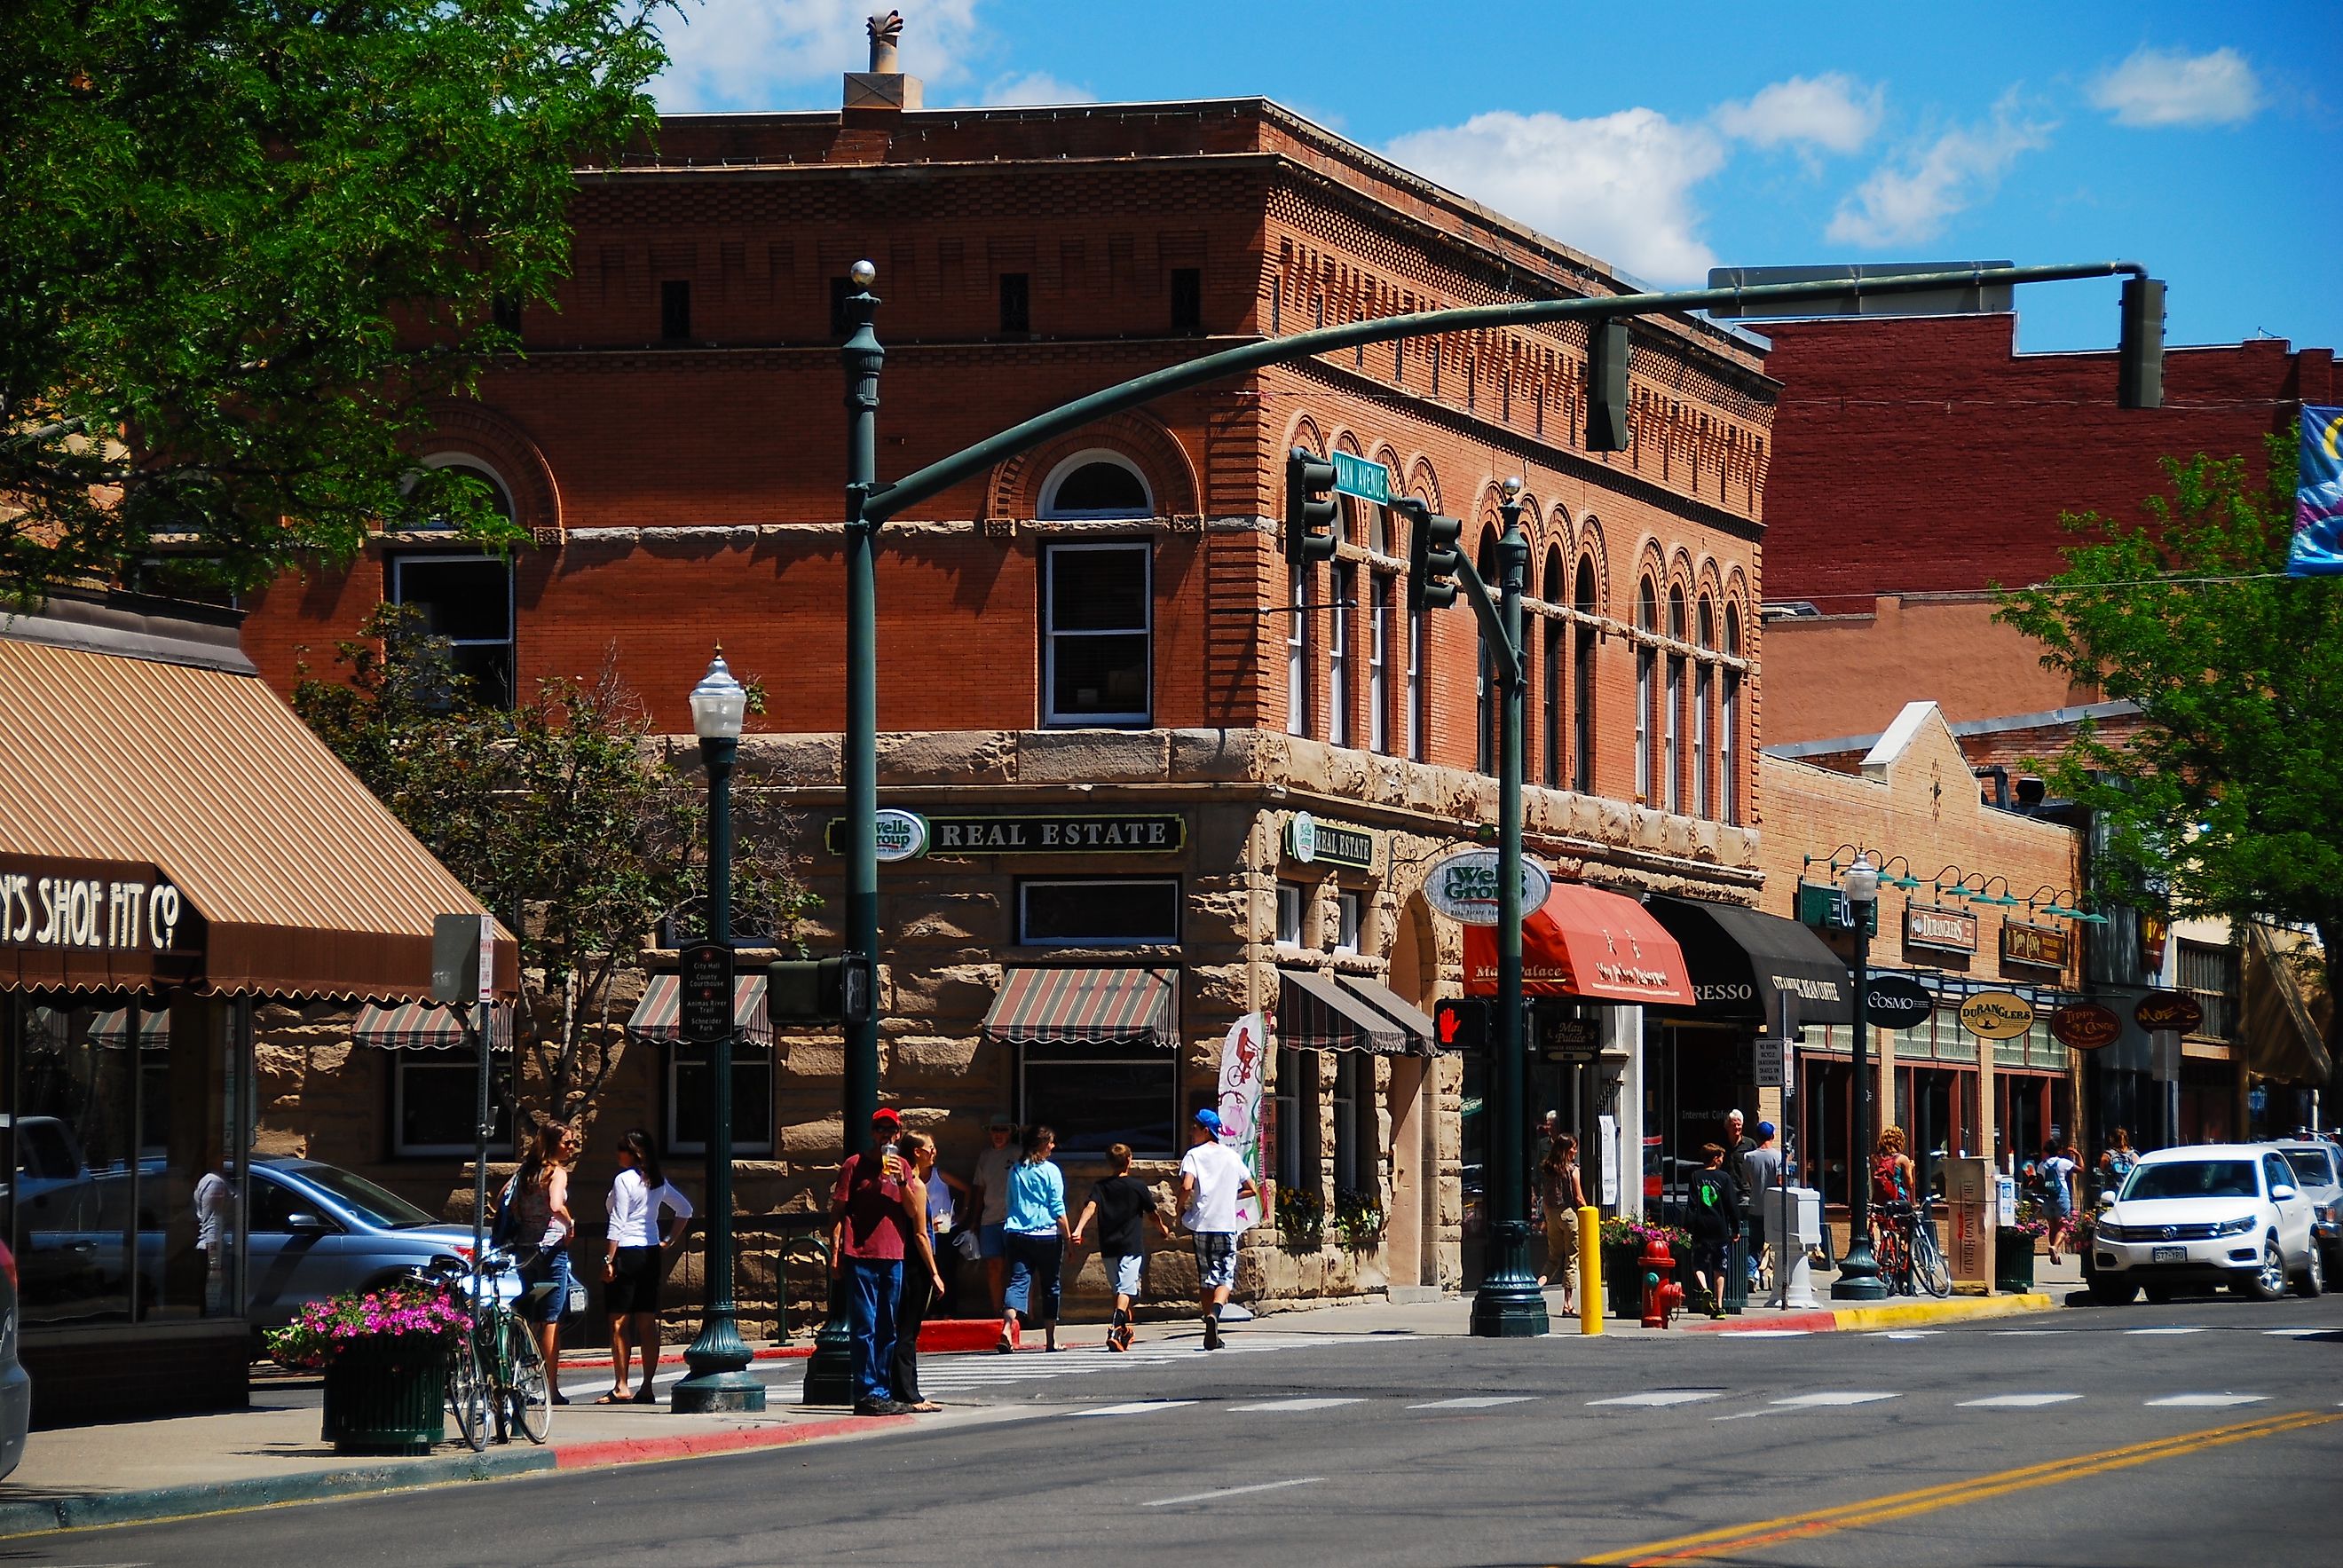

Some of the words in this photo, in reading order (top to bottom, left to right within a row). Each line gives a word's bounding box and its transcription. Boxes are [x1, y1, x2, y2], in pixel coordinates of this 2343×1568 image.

[1358, 463, 1384, 499] AVENUE
[941, 824, 1026, 846] REAL
[1041, 823, 1166, 844] ESTATE
[1314, 830, 1337, 854] REAL
[1338, 834, 1369, 861] ESTATE
[36, 877, 102, 947] SHOE
[108, 881, 144, 949] FIT
[1923, 914, 1962, 942] DURANGLERS
[1867, 991, 1913, 1010] COSMO
[1962, 1003, 2031, 1020] DURANGLERS
[1555, 1032, 1586, 1043] Palace
[1559, 1022, 1583, 1035] May
[1682, 1109, 1708, 1120] Internet
[1964, 1240, 1976, 1274] HERALD
